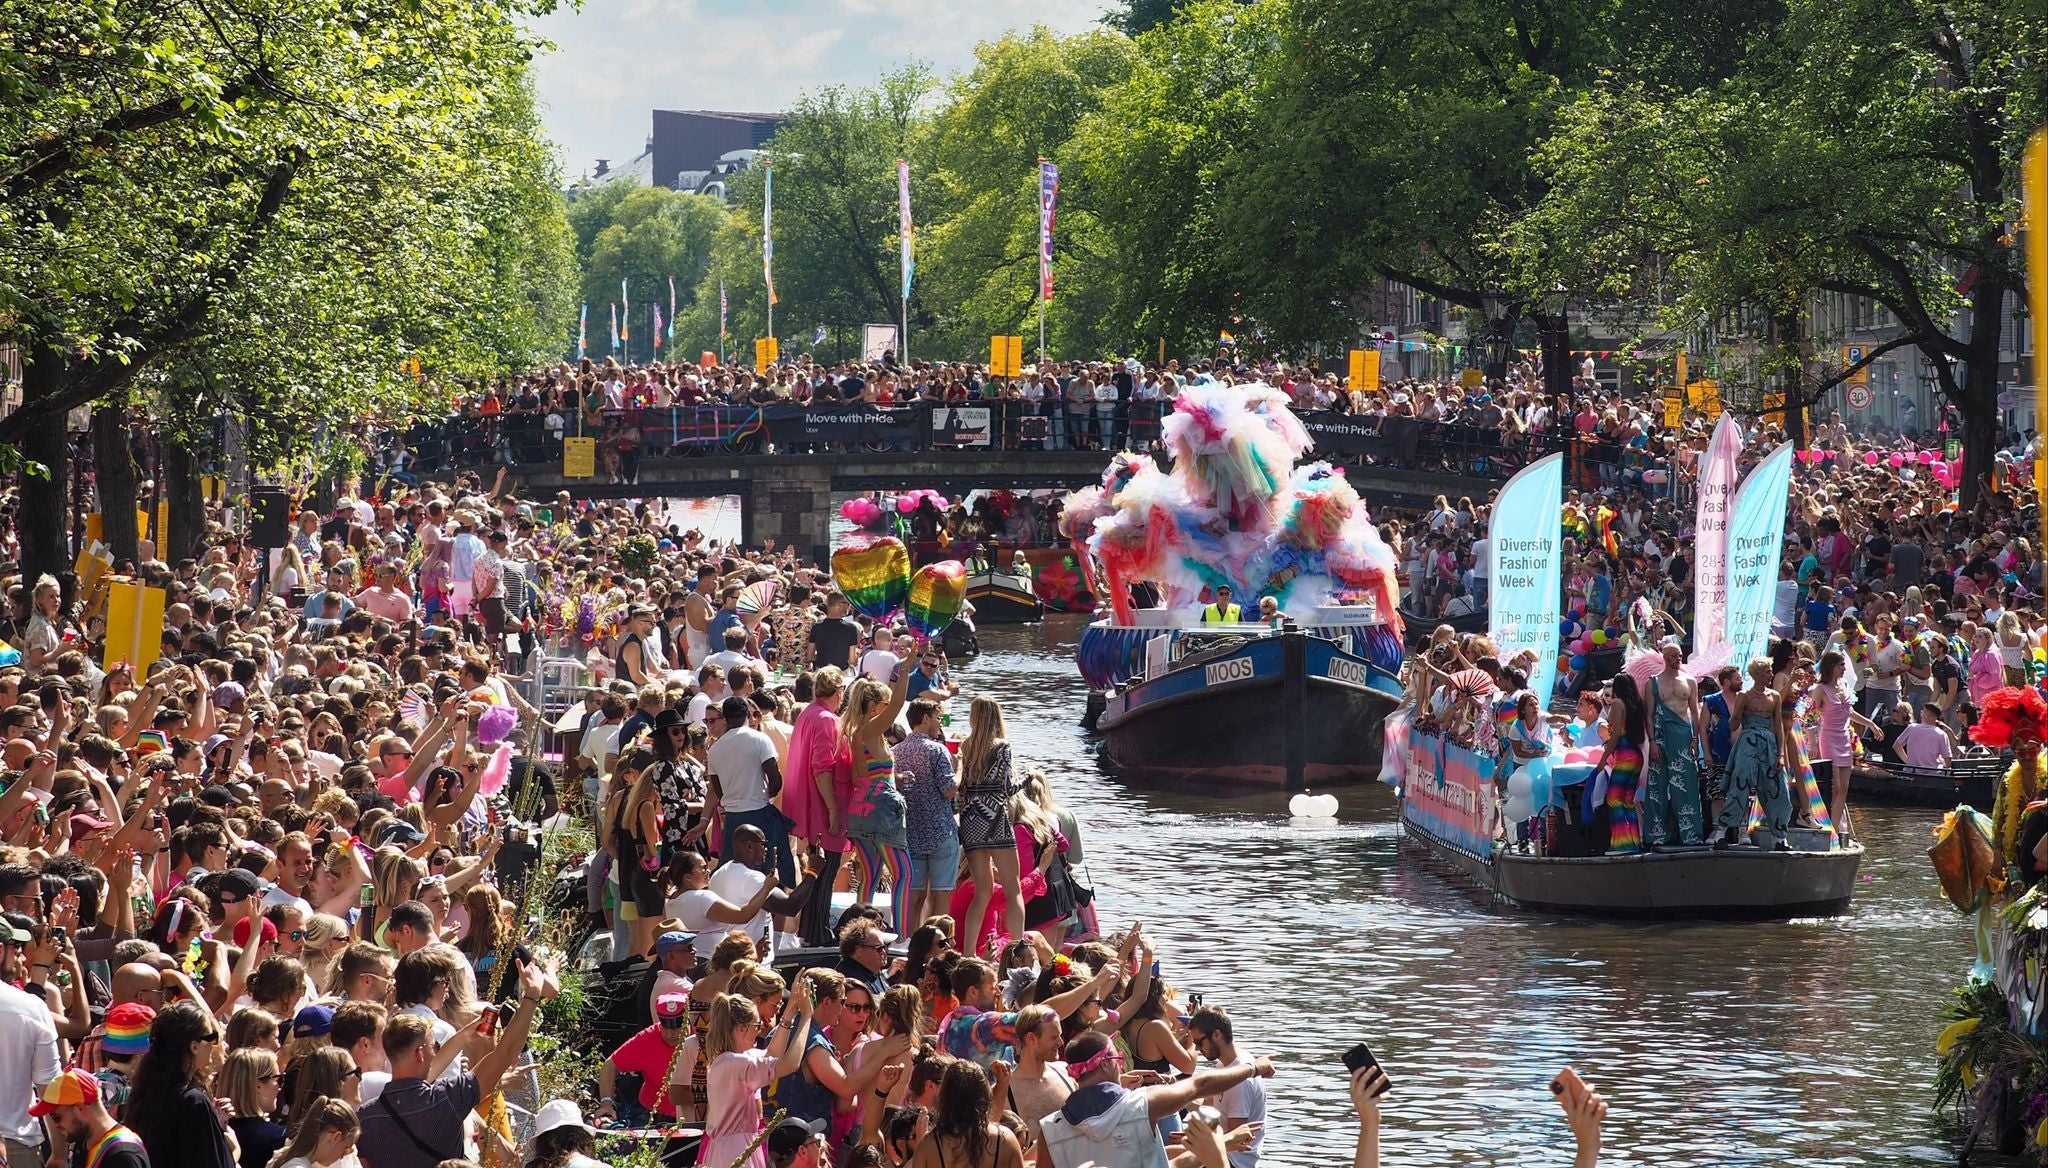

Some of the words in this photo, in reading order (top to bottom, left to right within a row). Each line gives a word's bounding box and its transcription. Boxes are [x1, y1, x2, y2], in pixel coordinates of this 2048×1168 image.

[805, 413, 837, 423] Move
[839, 413, 863, 423] with
[864, 413, 896, 424] Pride.
[1303, 422, 1324, 432] ove
[1325, 423, 1349, 435] with
[1500, 538, 1552, 554] Diversity
[1500, 556, 1547, 570] Fashion
[1499, 574, 1535, 588] Week
[1700, 590, 1726, 604] 2022
[1499, 610, 1521, 624] The
[1526, 610, 1554, 624] most
[1498, 629, 1551, 643] nclusive
[1546, 646, 1556, 660] in
[1207, 658, 1252, 684] MOOS
[1329, 658, 1366, 684] MOOS
